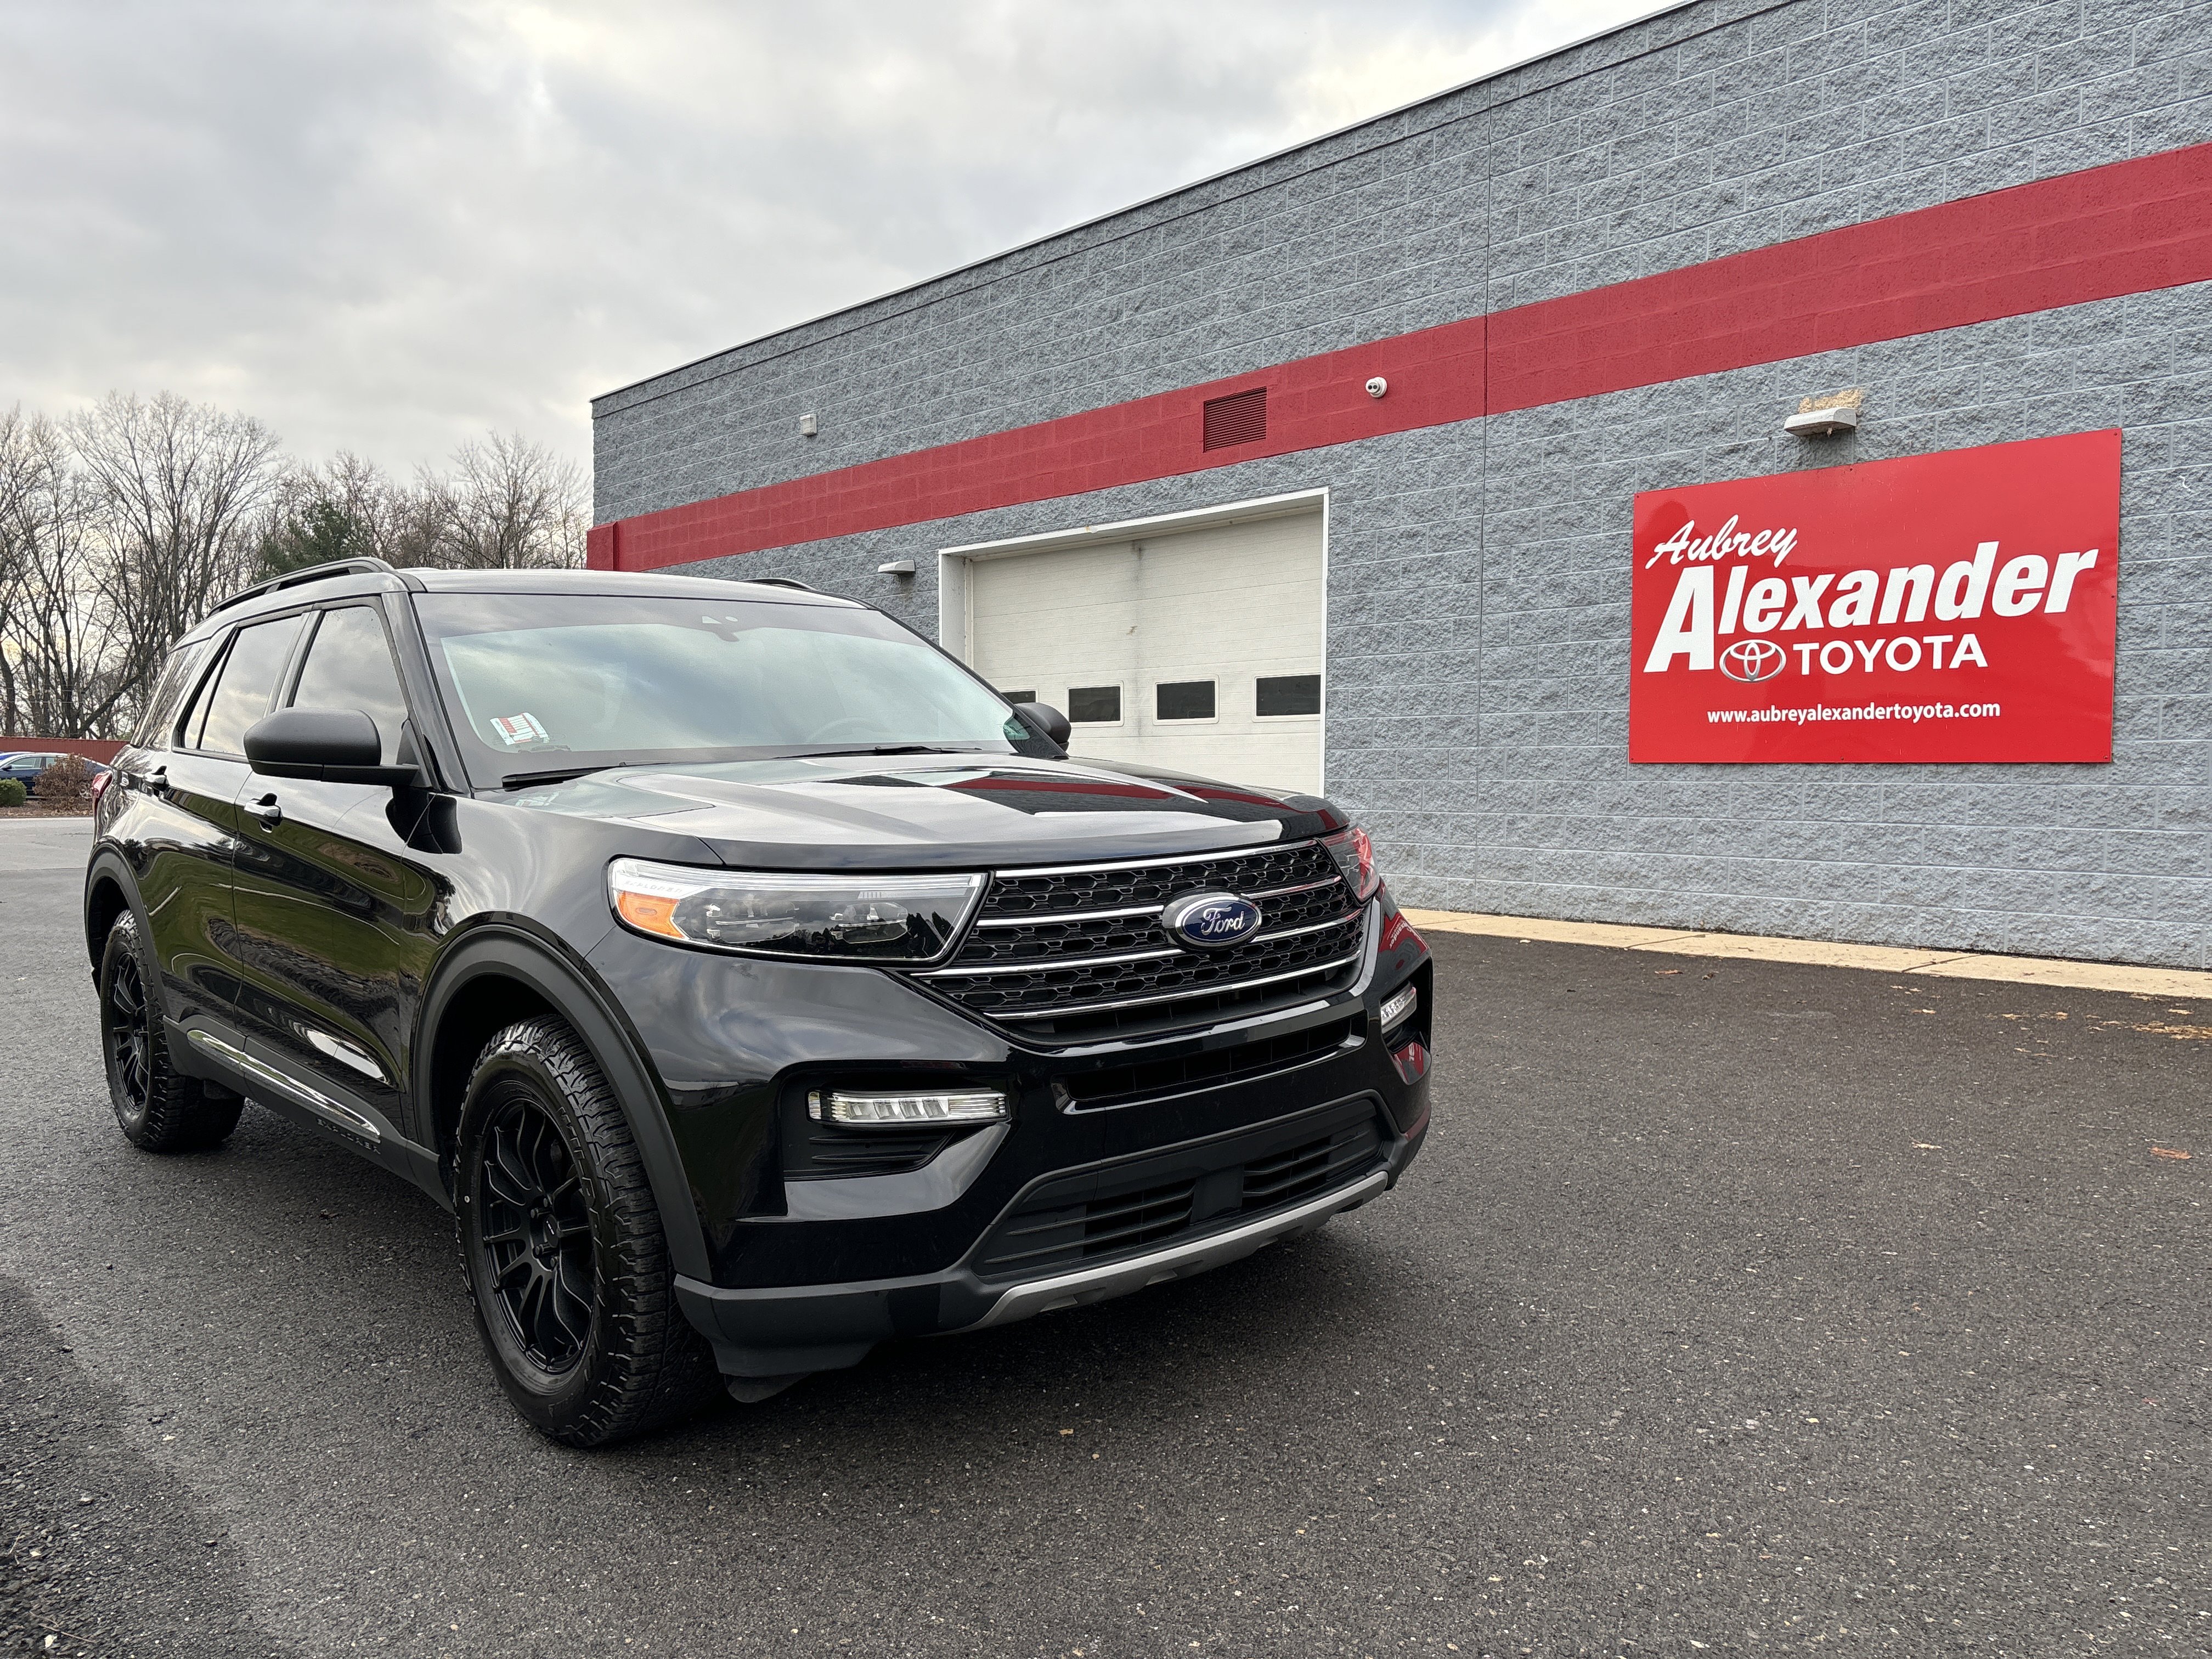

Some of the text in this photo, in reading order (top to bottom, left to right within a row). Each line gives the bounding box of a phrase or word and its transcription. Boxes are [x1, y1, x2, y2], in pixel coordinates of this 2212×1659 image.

[1645, 514, 1798, 569] Aubrey
[1643, 540, 2100, 673] Alexander
[1792, 633, 1989, 676] TOYOTA
[1707, 701, 2001, 726] www.aubreyalexandertoyota.com
[1200, 906, 1246, 936] Ford
